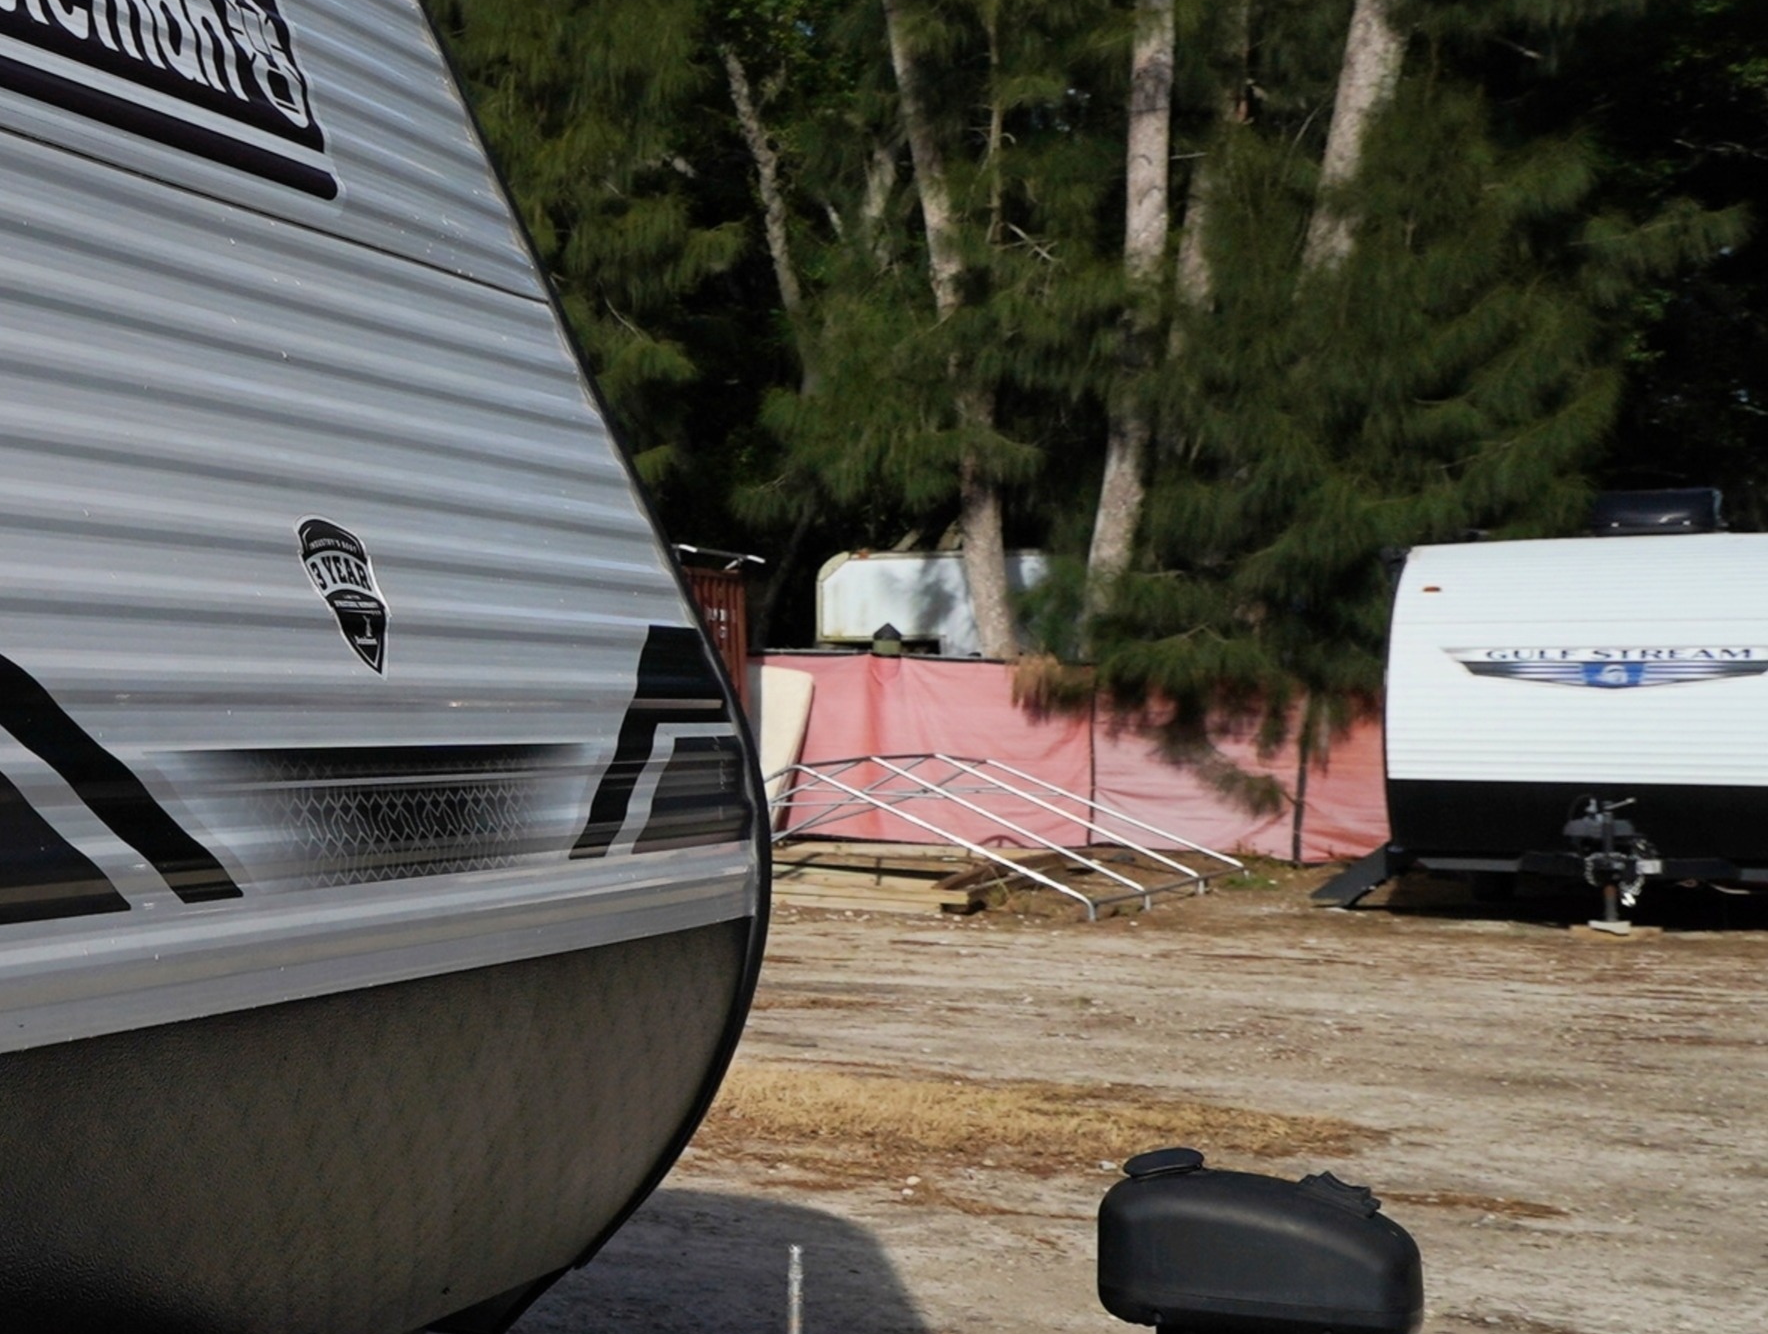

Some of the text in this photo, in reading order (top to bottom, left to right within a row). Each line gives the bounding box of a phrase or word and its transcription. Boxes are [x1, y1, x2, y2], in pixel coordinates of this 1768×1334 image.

[310, 555, 372, 592] 3 YEAR
[1485, 648, 1752, 661] GULF STREAM
